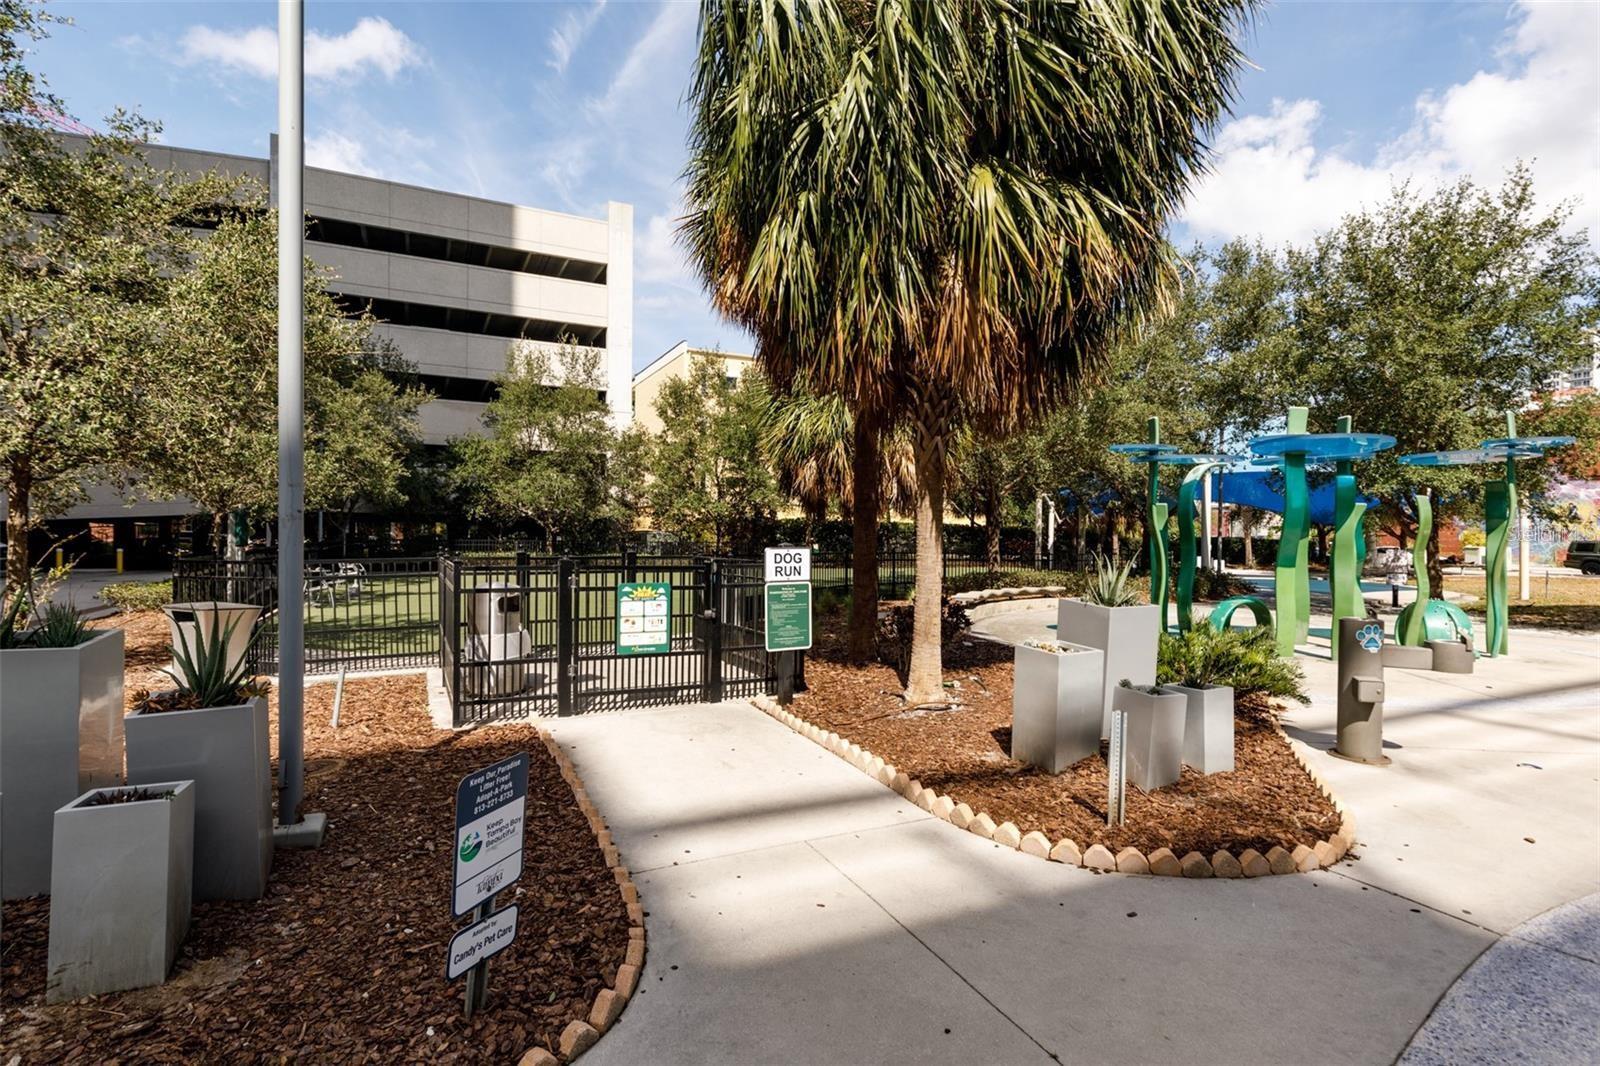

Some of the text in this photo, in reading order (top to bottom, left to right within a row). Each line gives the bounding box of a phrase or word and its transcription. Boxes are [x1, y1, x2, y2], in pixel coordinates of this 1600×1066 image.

[774, 553, 802, 564] DOG
[775, 566, 802, 577] RUN
[470, 776, 484, 788] Keep
[498, 760, 520, 774] Paradise
[486, 818, 504, 831] Keep
[487, 817, 522, 838] Tampa Bay
[486, 826, 516, 848] Beautiful
[454, 925, 512, 964] Candy's Pet Care
